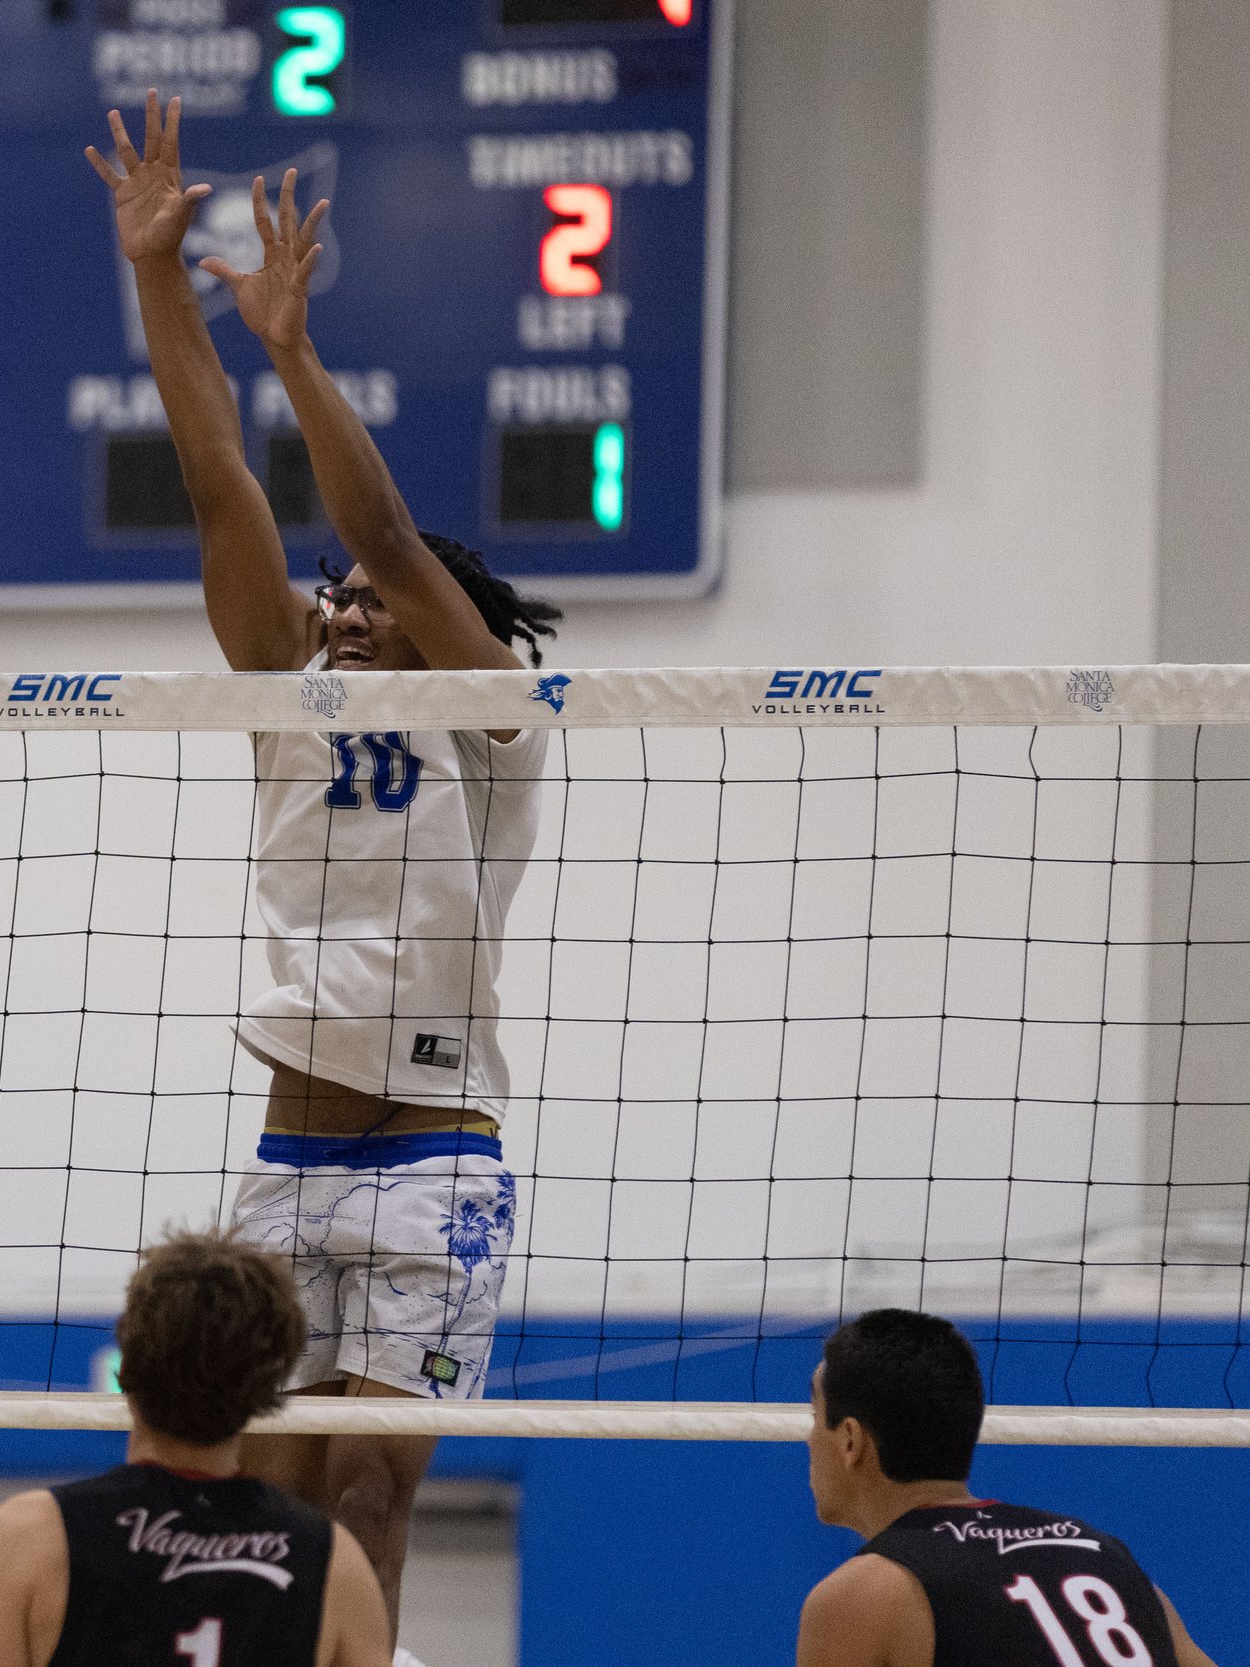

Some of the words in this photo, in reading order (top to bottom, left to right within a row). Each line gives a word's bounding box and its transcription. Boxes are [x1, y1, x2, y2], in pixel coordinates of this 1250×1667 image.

[272, 6, 345, 116] 2
[463, 50, 617, 105] BONUS
[468, 132, 692, 187] TIMEOUTS
[540, 184, 612, 296] 2
[518, 295, 631, 348] LEFT
[488, 366, 632, 422] FOULS
[592, 423, 624, 530] 1
[7, 674, 122, 701] SMC
[301, 688, 347, 699] MONICA
[304, 676, 344, 688] SANTA
[765, 670, 882, 698] SMC
[1066, 681, 1115, 692] MONICA
[1070, 668, 1111, 681] SANTA
[302, 699, 346, 718] COLLEGE
[752, 704, 885, 714] VOLLEYBALL
[1068, 692, 1112, 712] COLLEGE
[325, 731, 424, 812] 10
[116, 1507, 294, 1588] Vaqueros
[932, 1520, 1100, 1555] Vaqueros
[174, 1617, 223, 1667] 1
[1003, 1573, 1153, 1667] 18
